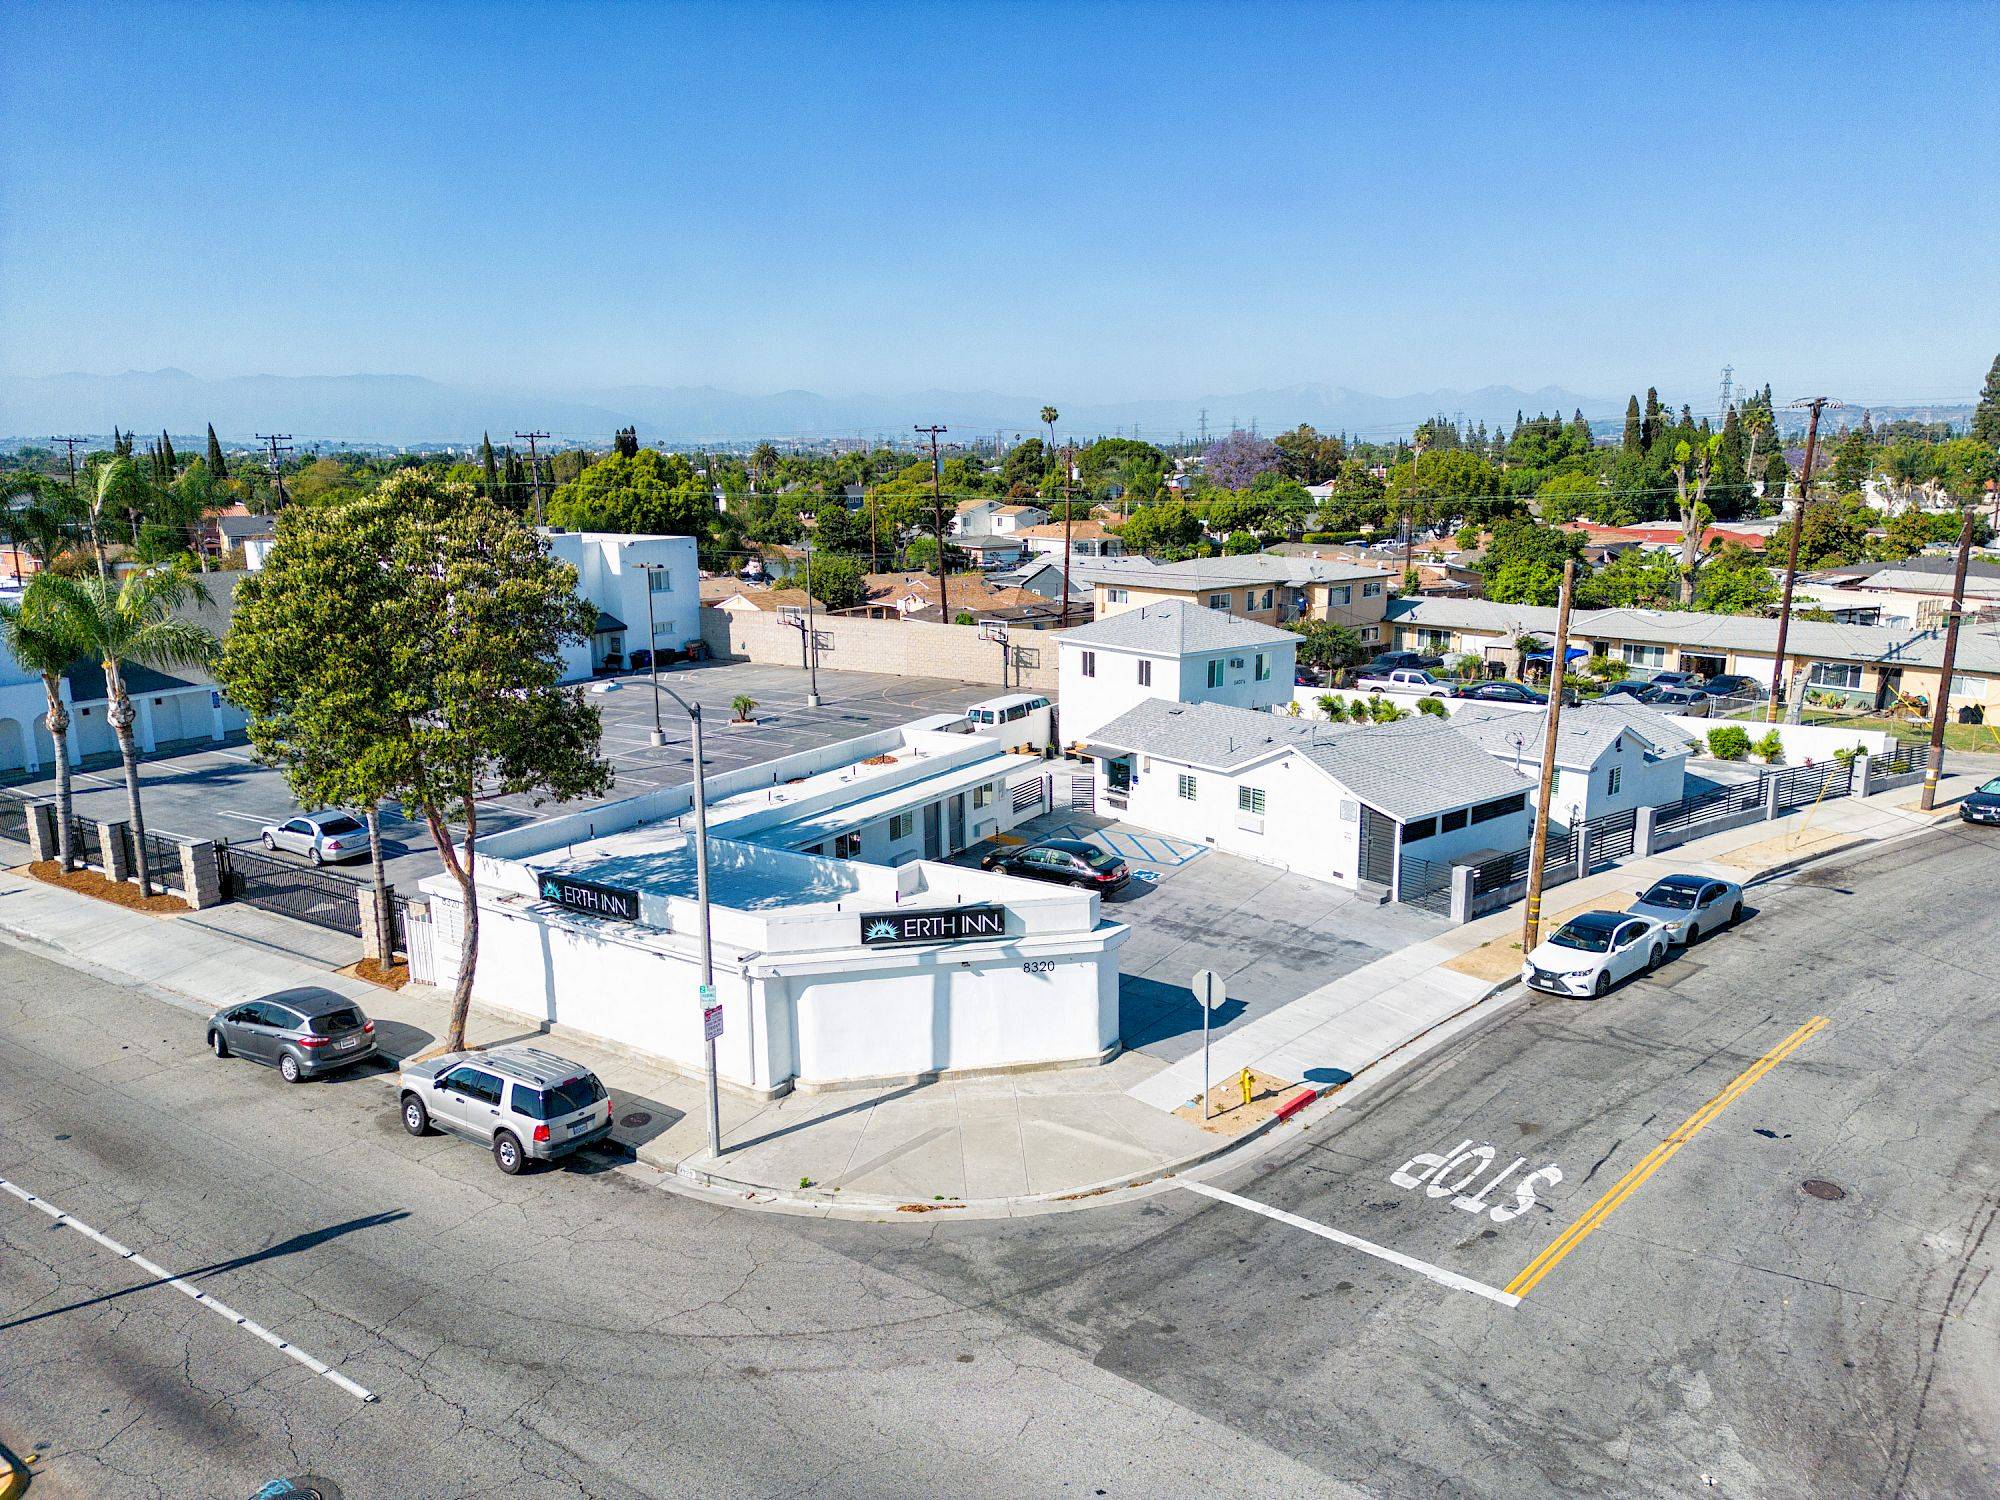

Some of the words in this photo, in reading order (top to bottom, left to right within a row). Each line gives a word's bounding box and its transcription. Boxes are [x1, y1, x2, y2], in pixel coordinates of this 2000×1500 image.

[564, 885, 599, 909] ERTH
[904, 916, 956, 938] ERTH
[1023, 960, 1055, 973] 8320
[1389, 1139, 1563, 1222] STOP
